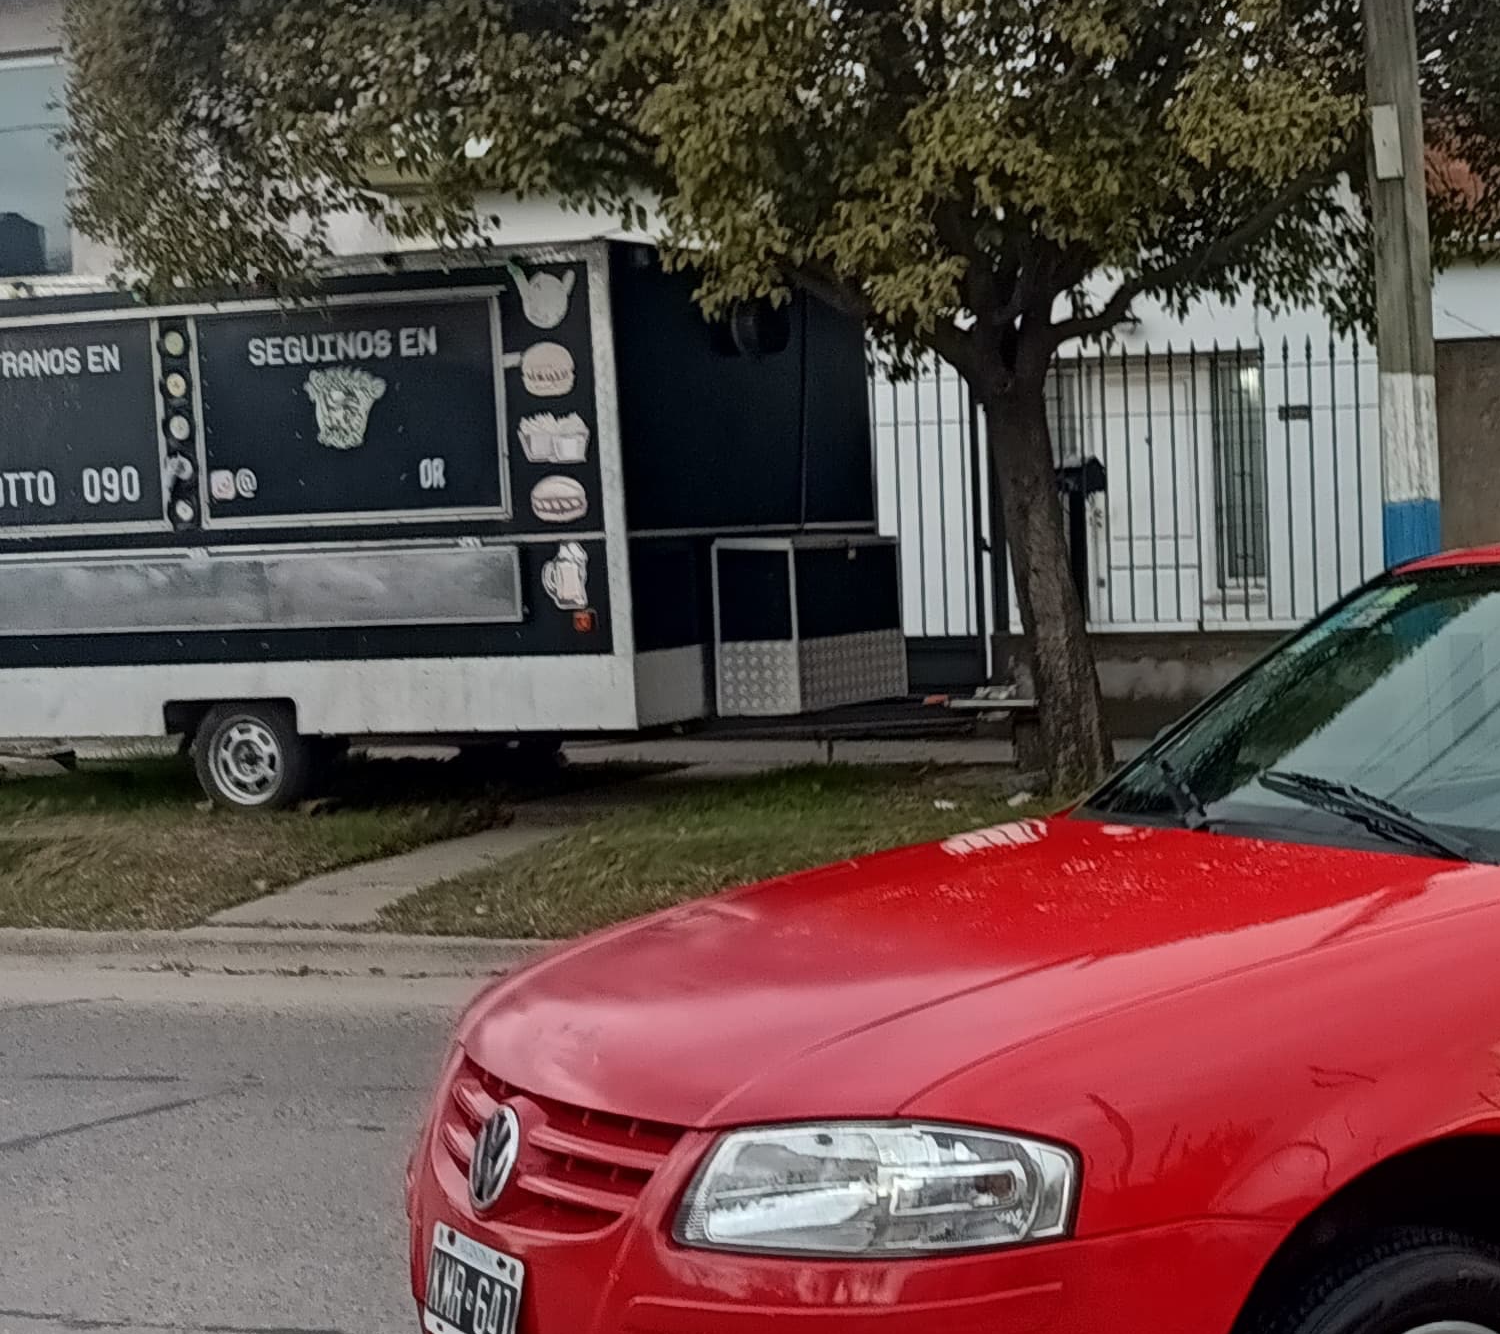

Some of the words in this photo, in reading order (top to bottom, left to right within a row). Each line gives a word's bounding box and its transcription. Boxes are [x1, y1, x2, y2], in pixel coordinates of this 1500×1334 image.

[0, 347, 82, 379] RANOS
[86, 343, 121, 374] EN
[248, 328, 393, 367] SEGUINOS
[400, 325, 438, 357] EN
[0, 469, 56, 507] TTO
[82, 465, 141, 505] 090
[419, 457, 446, 490] OR
